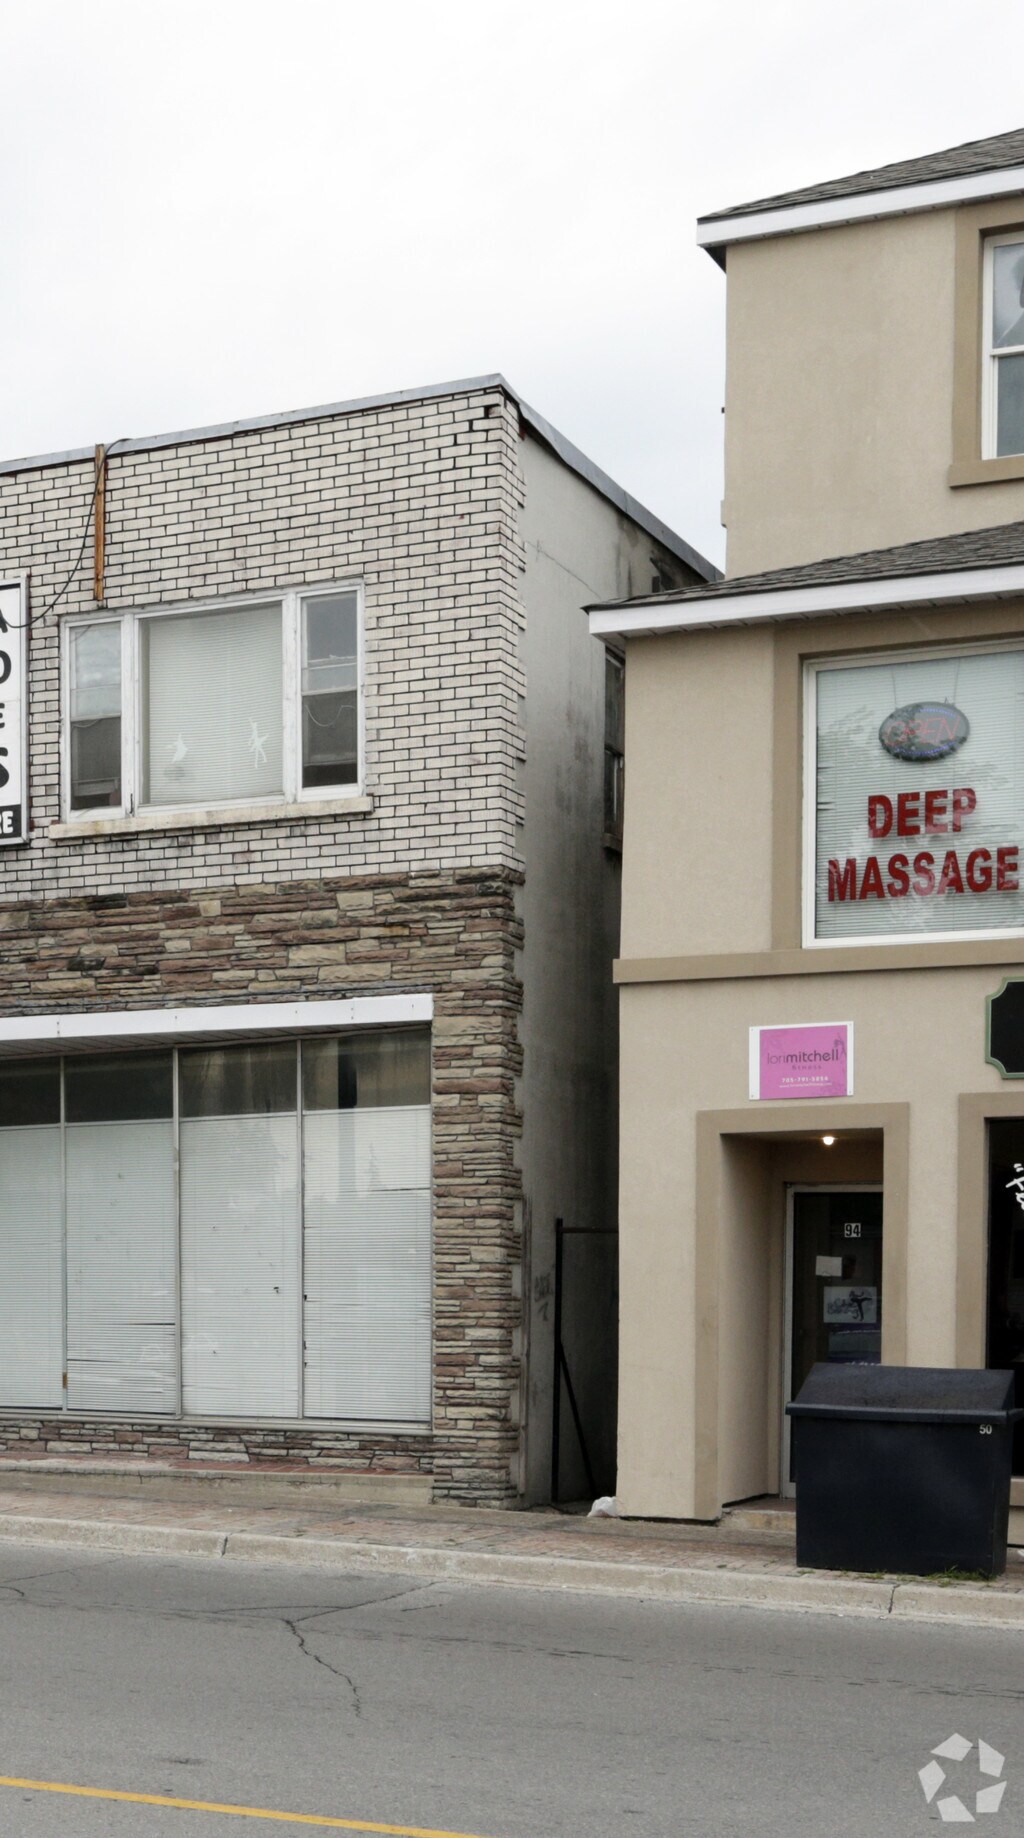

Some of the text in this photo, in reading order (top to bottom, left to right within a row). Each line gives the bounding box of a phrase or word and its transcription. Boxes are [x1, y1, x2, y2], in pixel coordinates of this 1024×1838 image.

[883, 714, 962, 747] OPEN
[867, 787, 977, 839] DEEP
[827, 845, 1020, 902] MASSAGE
[845, 1224, 861, 1237] 94
[979, 1424, 993, 1435] 50
